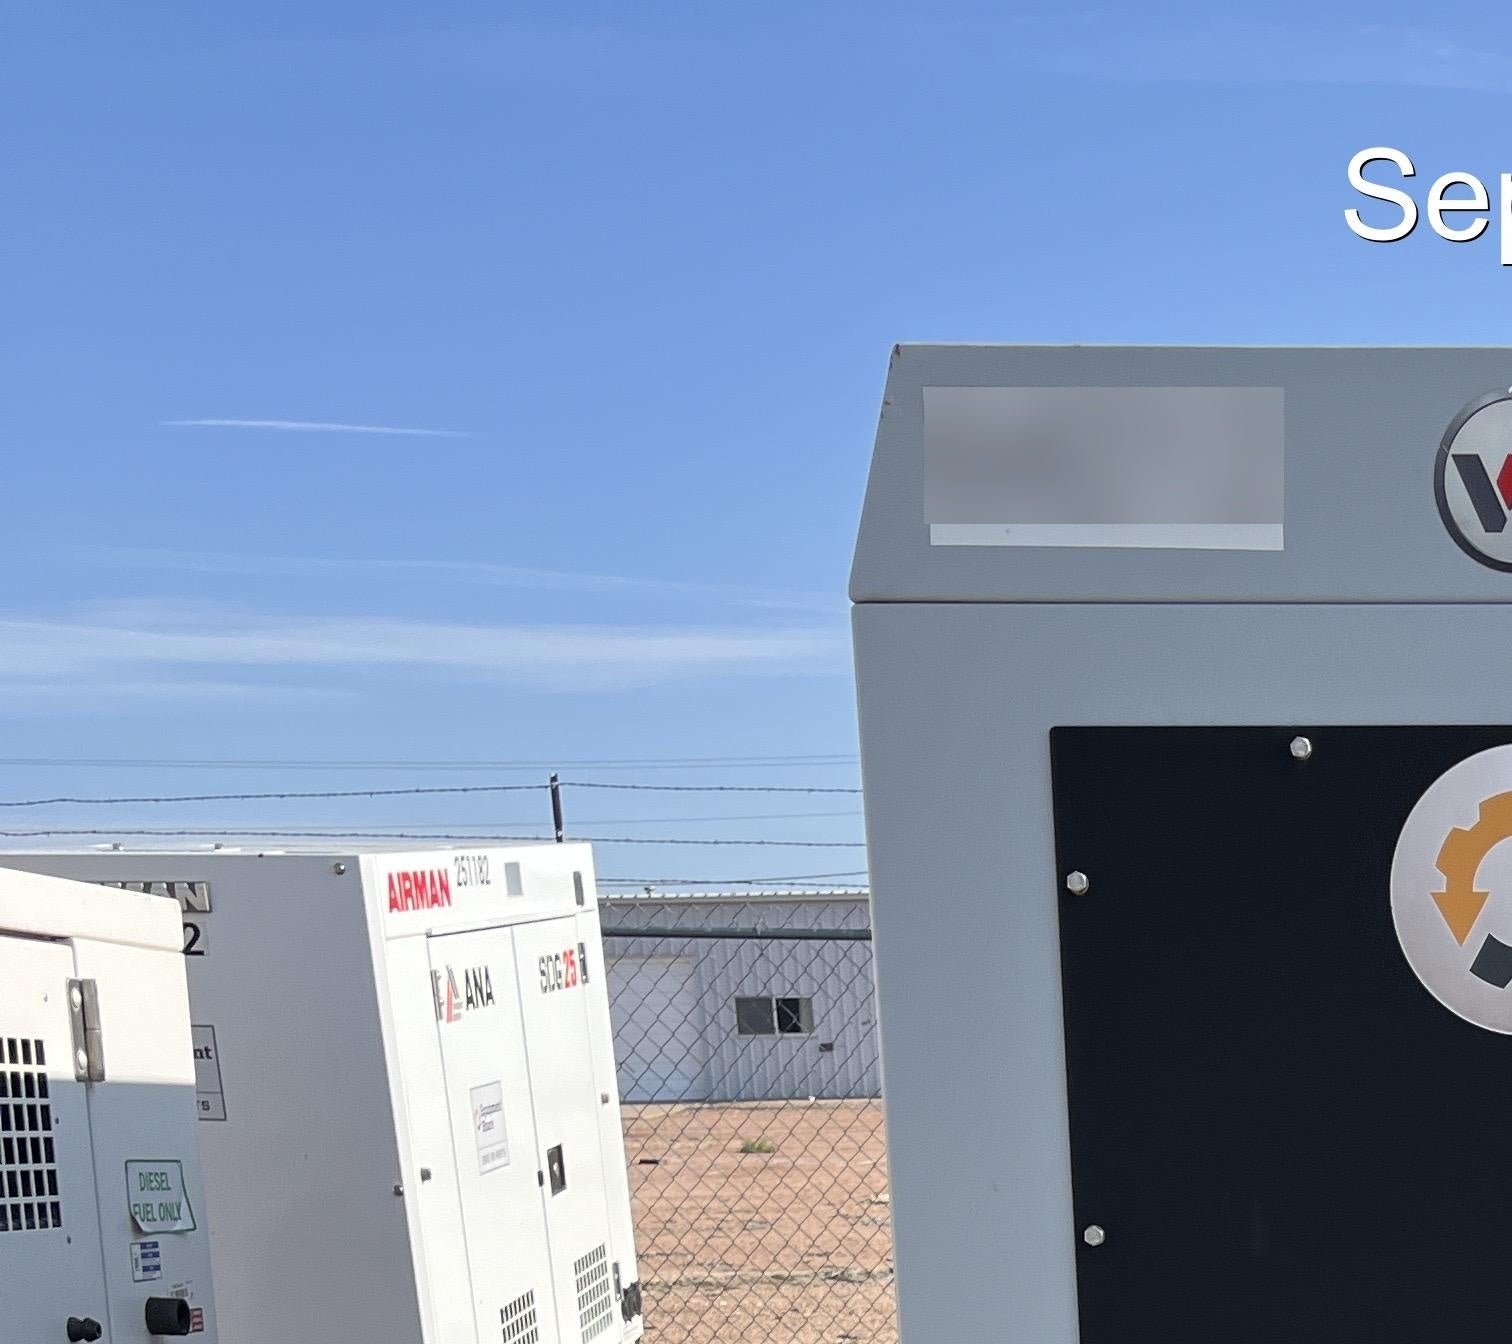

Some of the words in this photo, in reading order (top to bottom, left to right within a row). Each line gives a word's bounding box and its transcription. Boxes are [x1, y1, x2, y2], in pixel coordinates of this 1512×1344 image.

[387, 868, 452, 913] AIRMAN
[465, 965, 495, 1011] ANA
[138, 1172, 172, 1192] DIESEL
[132, 1203, 157, 1222] FUEL
[158, 1201, 182, 1222] ONLY
